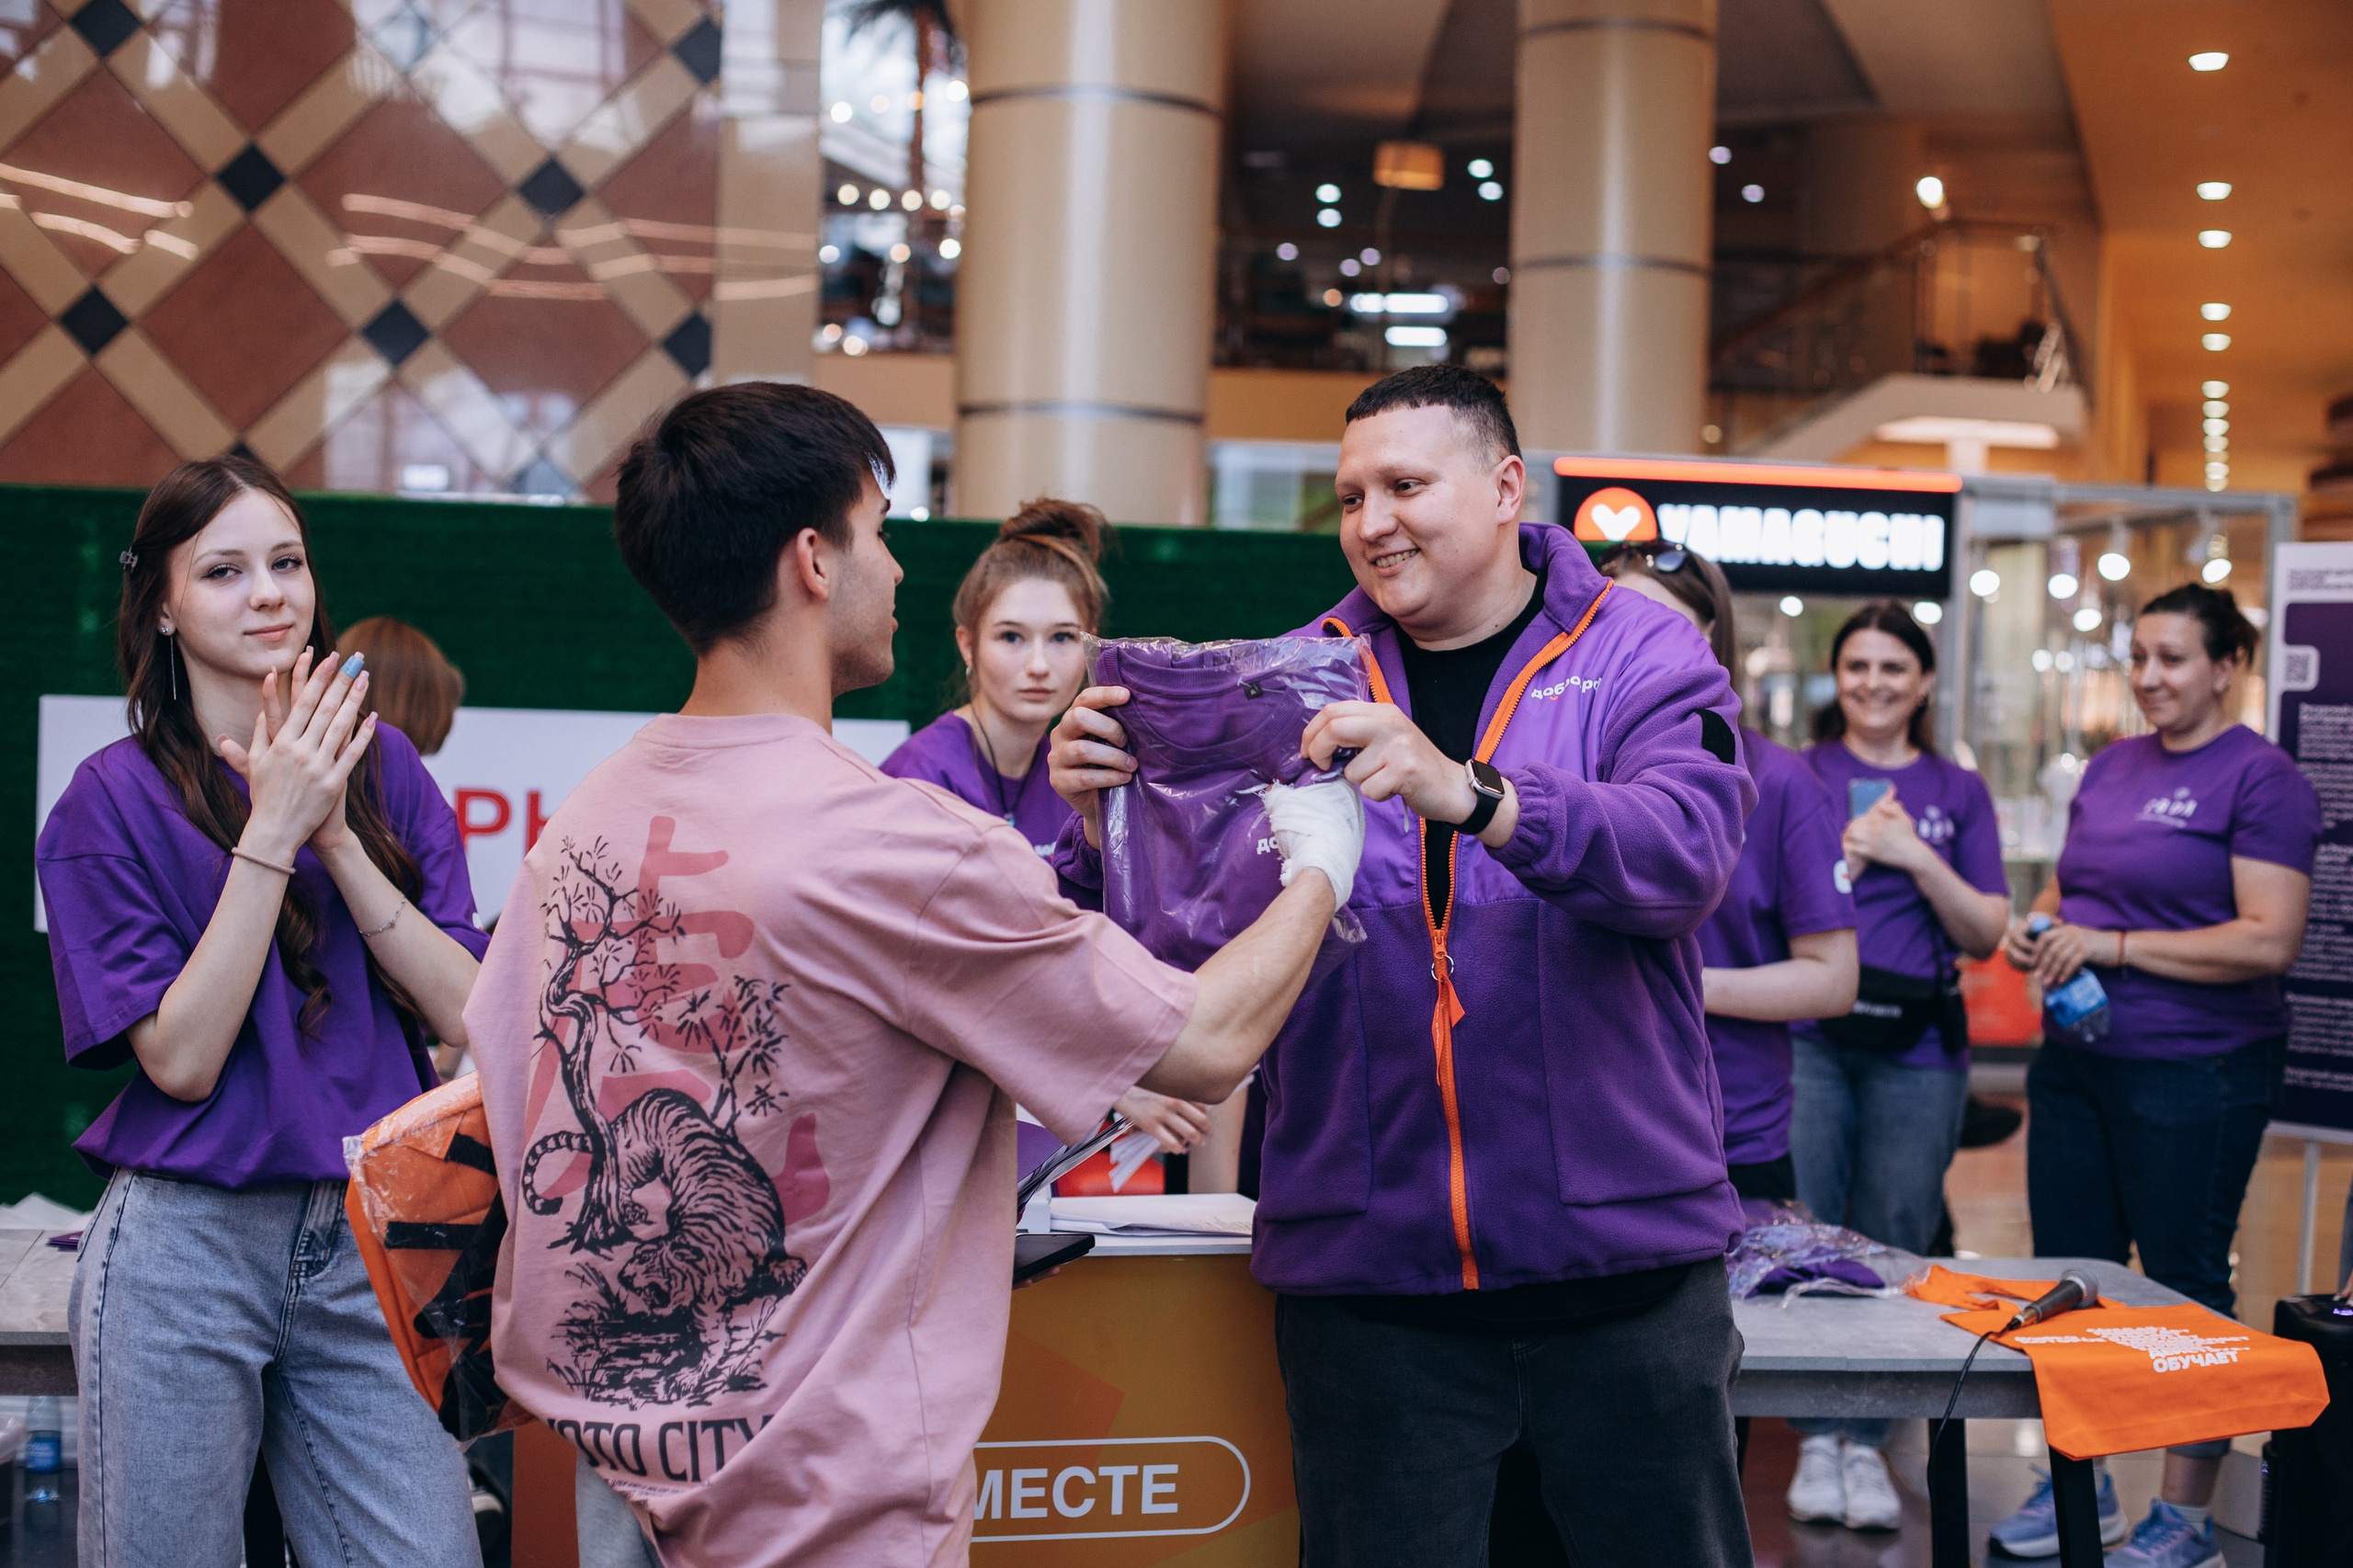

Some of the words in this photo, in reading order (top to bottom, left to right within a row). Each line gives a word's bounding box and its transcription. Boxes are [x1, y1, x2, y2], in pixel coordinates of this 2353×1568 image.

[2153, 1351, 2238, 1373] ОБУЧАЕТ
[548, 1418, 648, 1477] OTO
[974, 1464, 1178, 1520] МЕСТЕ
